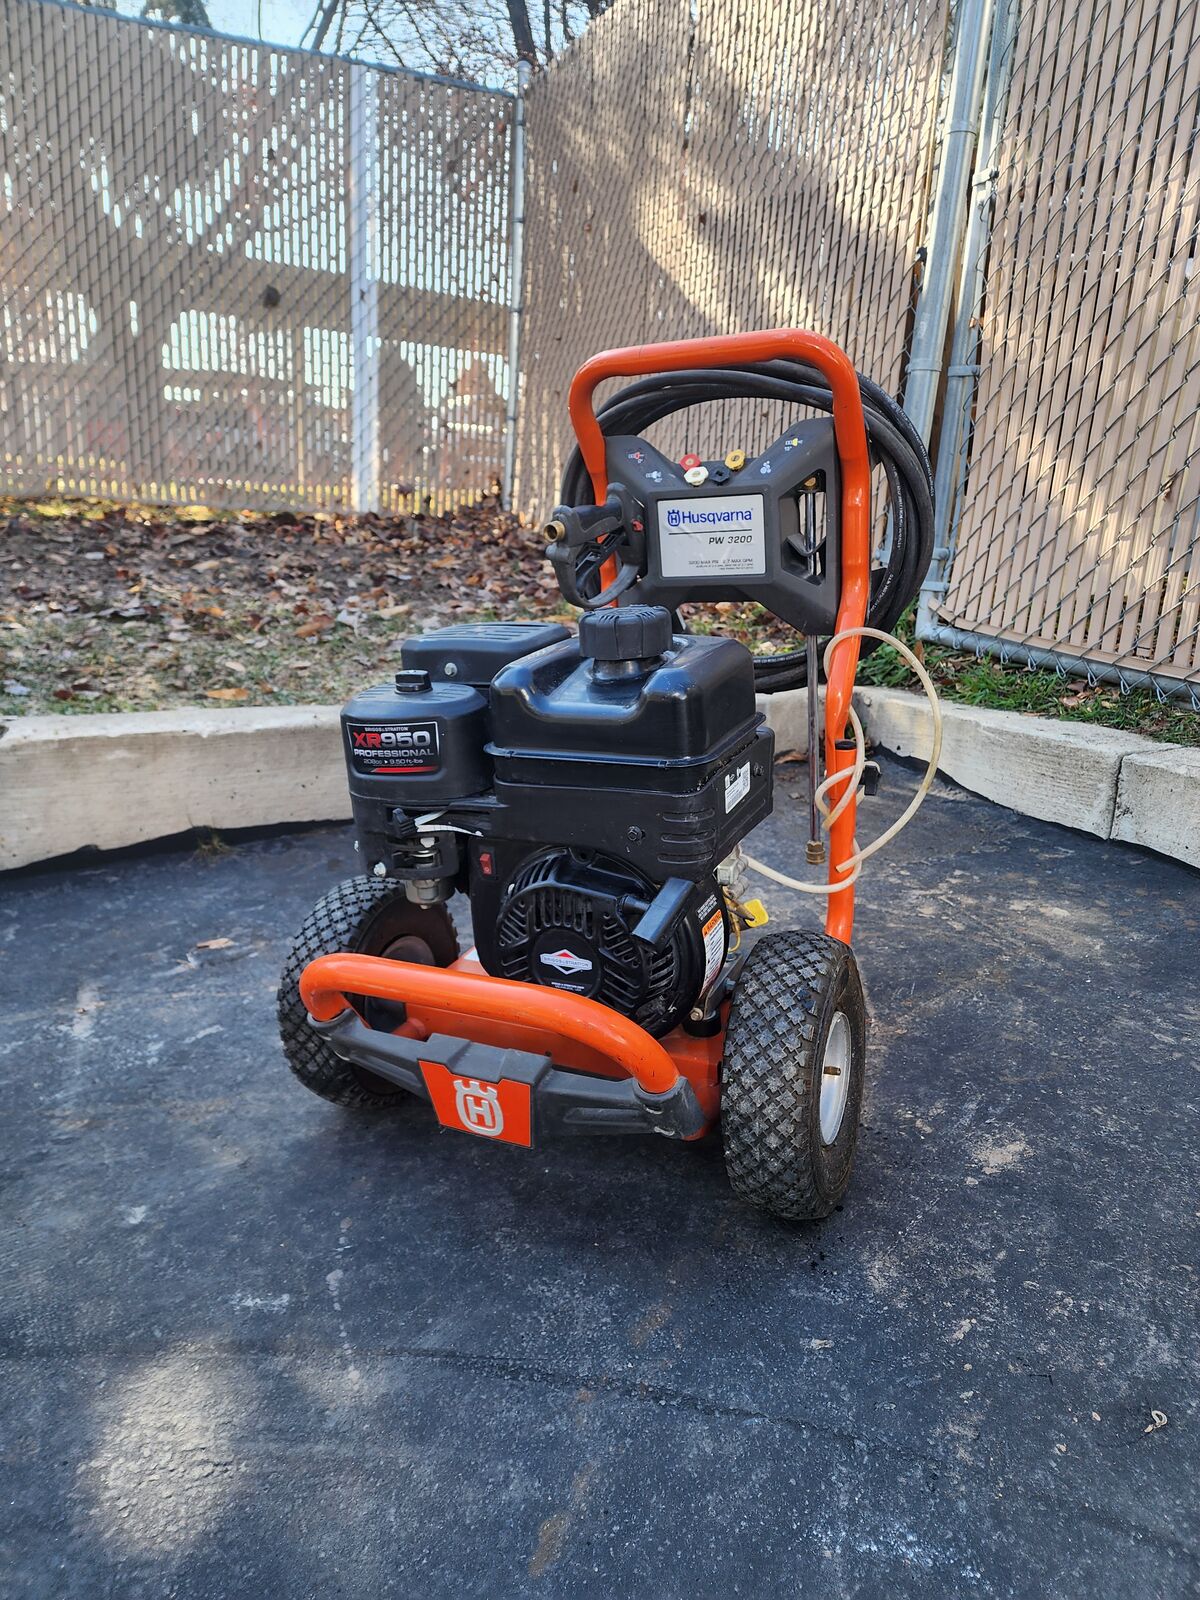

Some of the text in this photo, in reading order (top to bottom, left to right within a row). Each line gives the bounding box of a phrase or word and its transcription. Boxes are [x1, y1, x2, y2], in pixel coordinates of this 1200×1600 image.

[682, 510, 752, 524] Husqvarna
[708, 535, 753, 545] PW 3200
[353, 730, 431, 748] XR950
[353, 748, 435, 758] PROFESSIONAL
